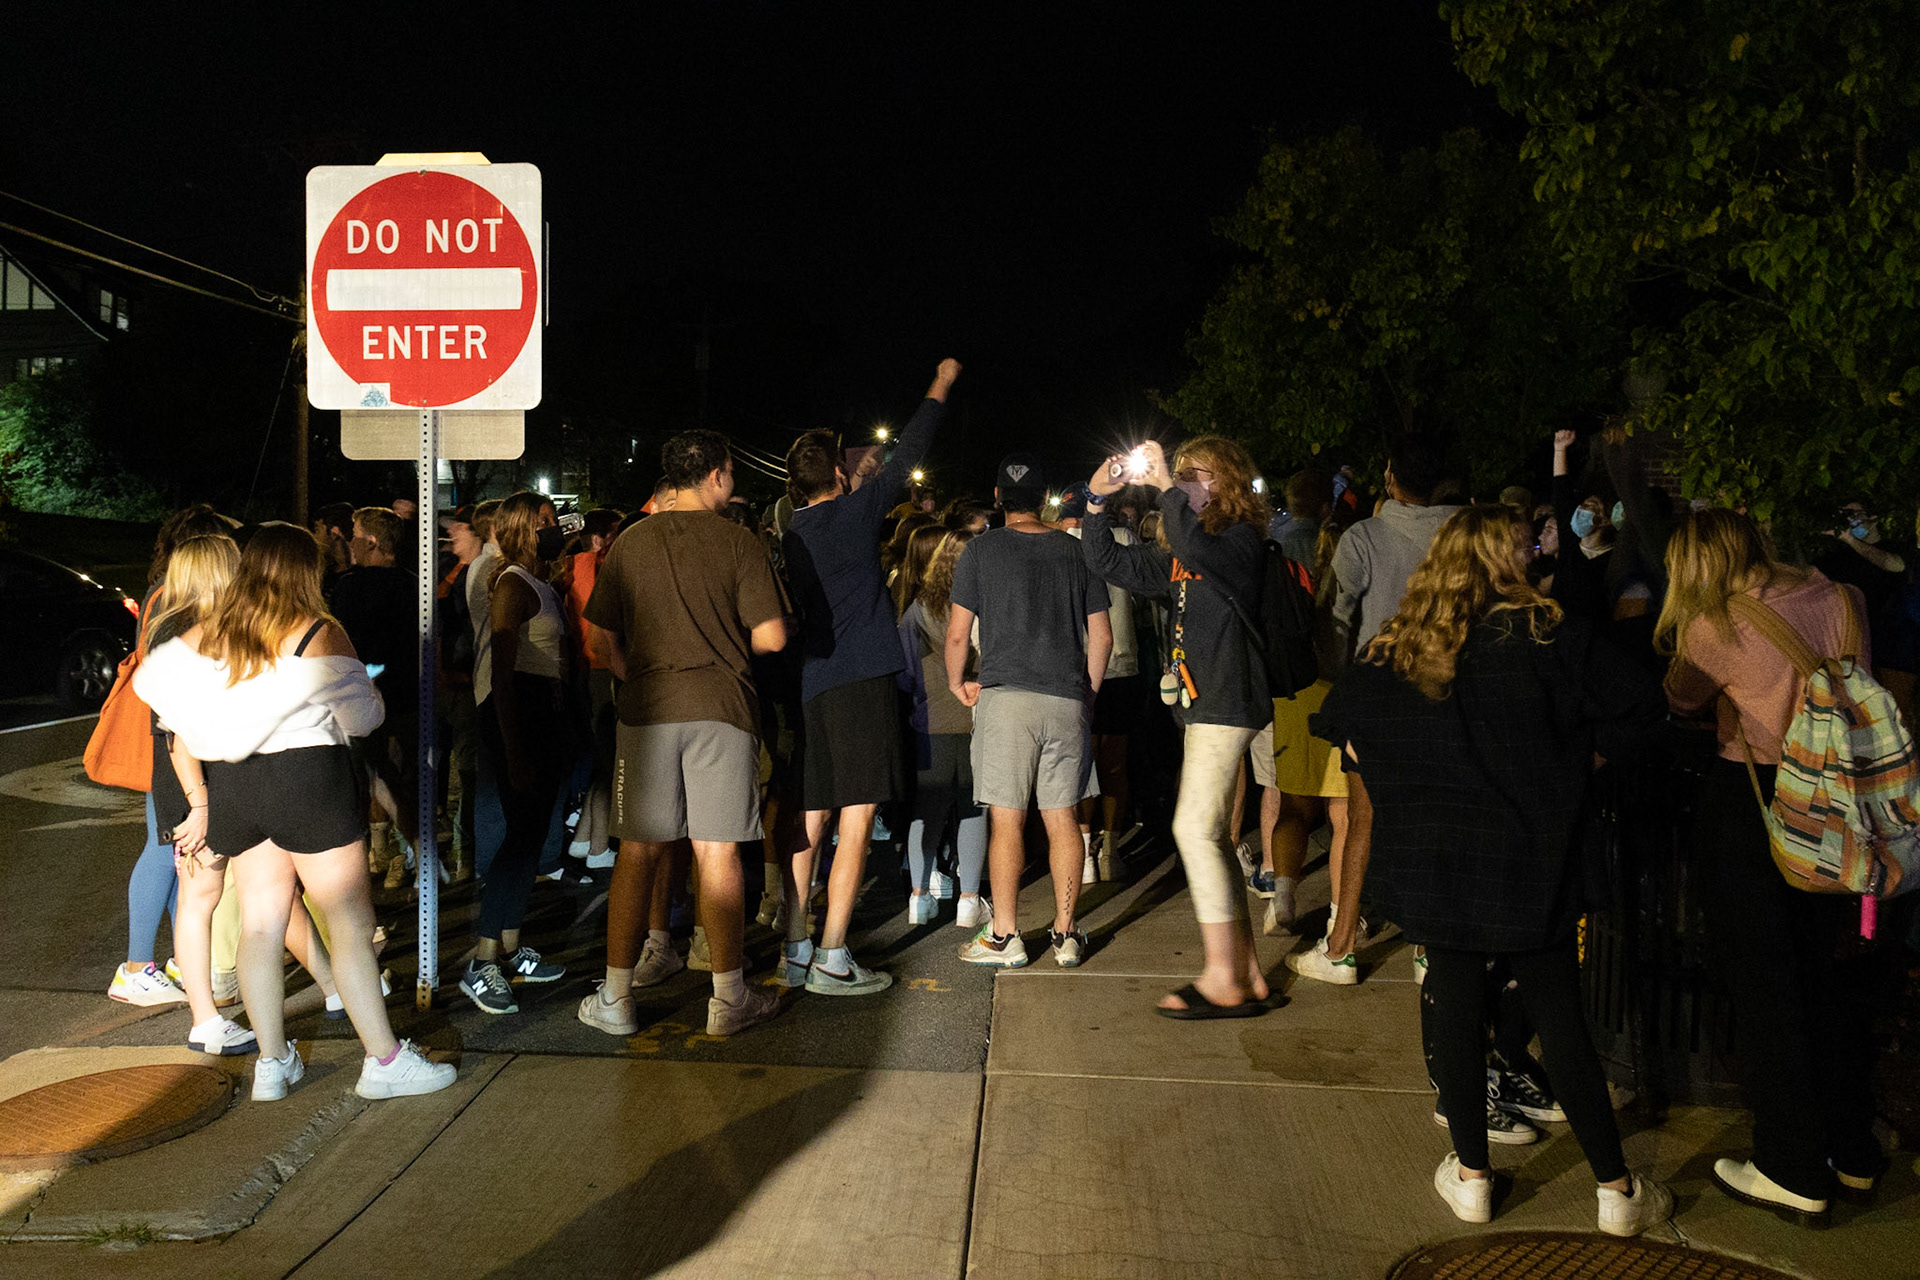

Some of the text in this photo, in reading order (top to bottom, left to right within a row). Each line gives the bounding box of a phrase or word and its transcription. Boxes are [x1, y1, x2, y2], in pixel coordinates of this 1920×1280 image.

[347, 218, 503, 254] DO NOT
[363, 325, 487, 360] ENTER
[617, 759, 625, 825] SYRACUSE
[518, 960, 538, 975] N
[472, 980, 488, 996] N
